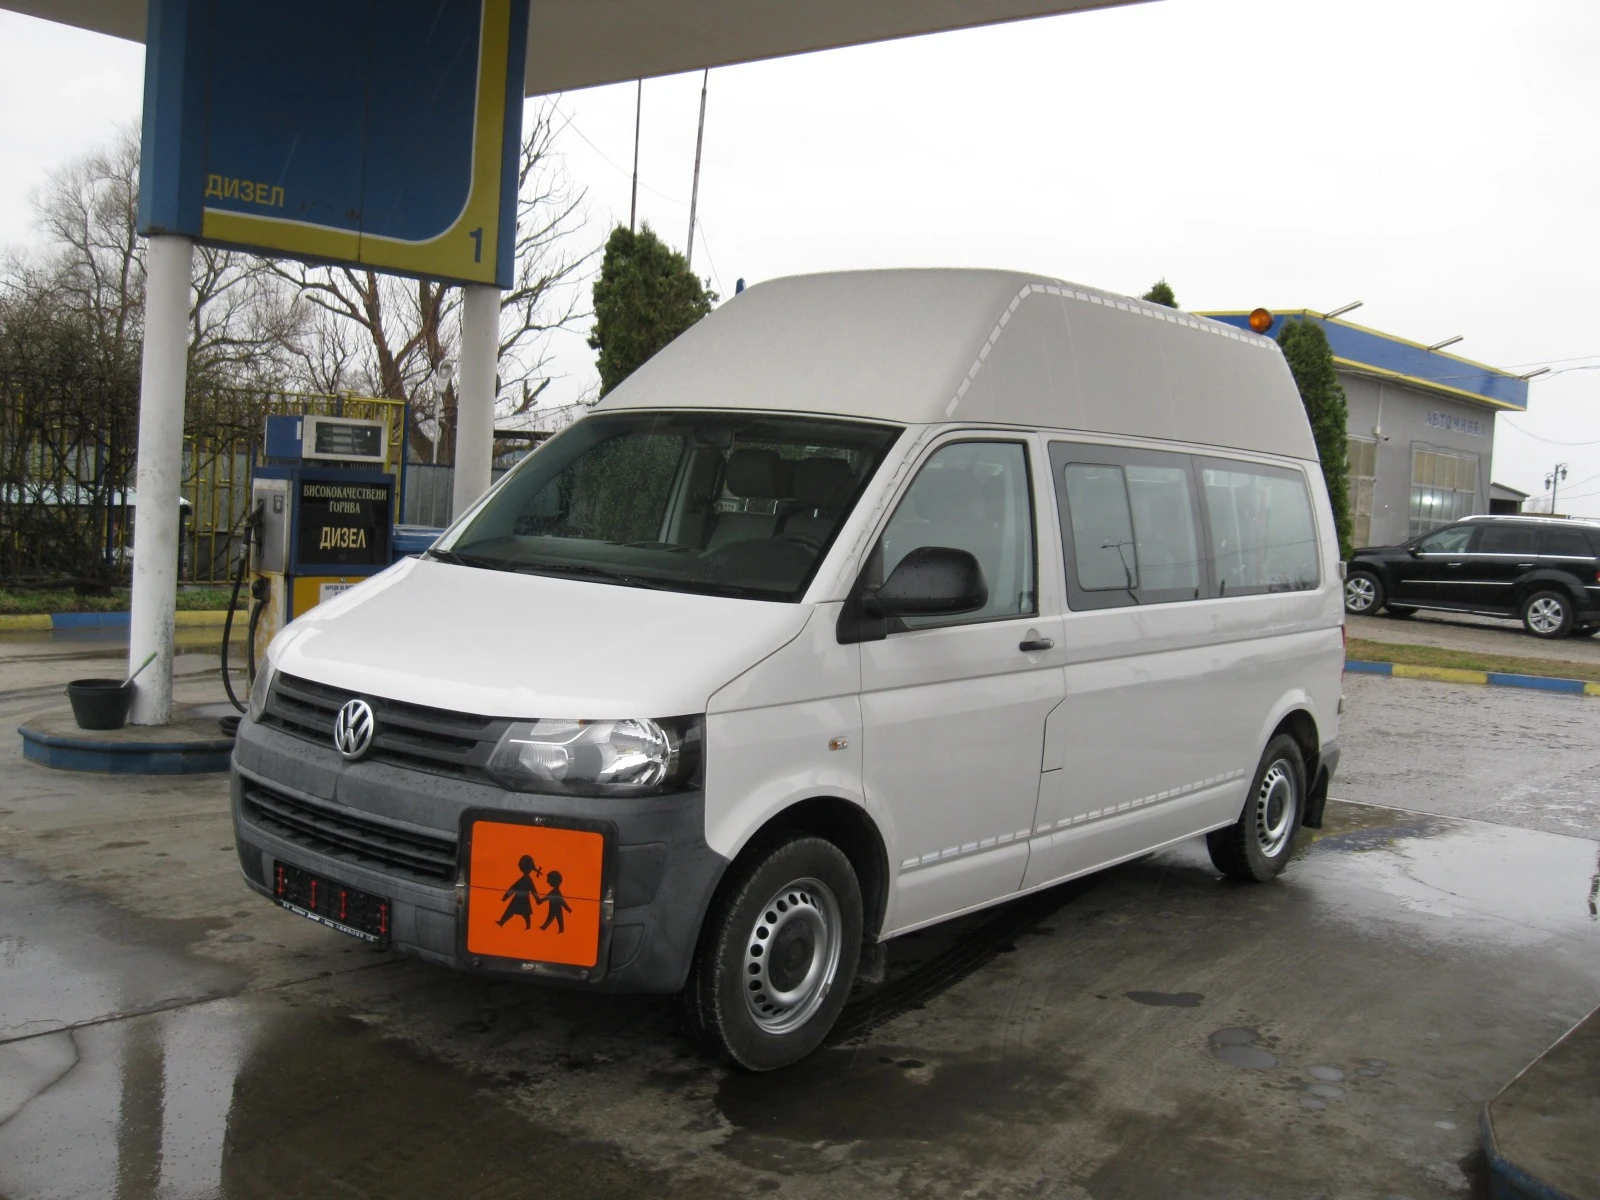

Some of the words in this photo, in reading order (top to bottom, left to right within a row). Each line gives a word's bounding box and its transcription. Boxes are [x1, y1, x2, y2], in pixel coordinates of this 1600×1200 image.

[205, 173, 285, 208] ДИЗЕЛ
[469, 227, 483, 263] 1
[303, 484, 387, 501] ВИСОКОКАЧЕСТВЕНИ
[329, 501, 361, 514] ГОРИВА
[319, 527, 366, 550] ДИЗЕЛ
